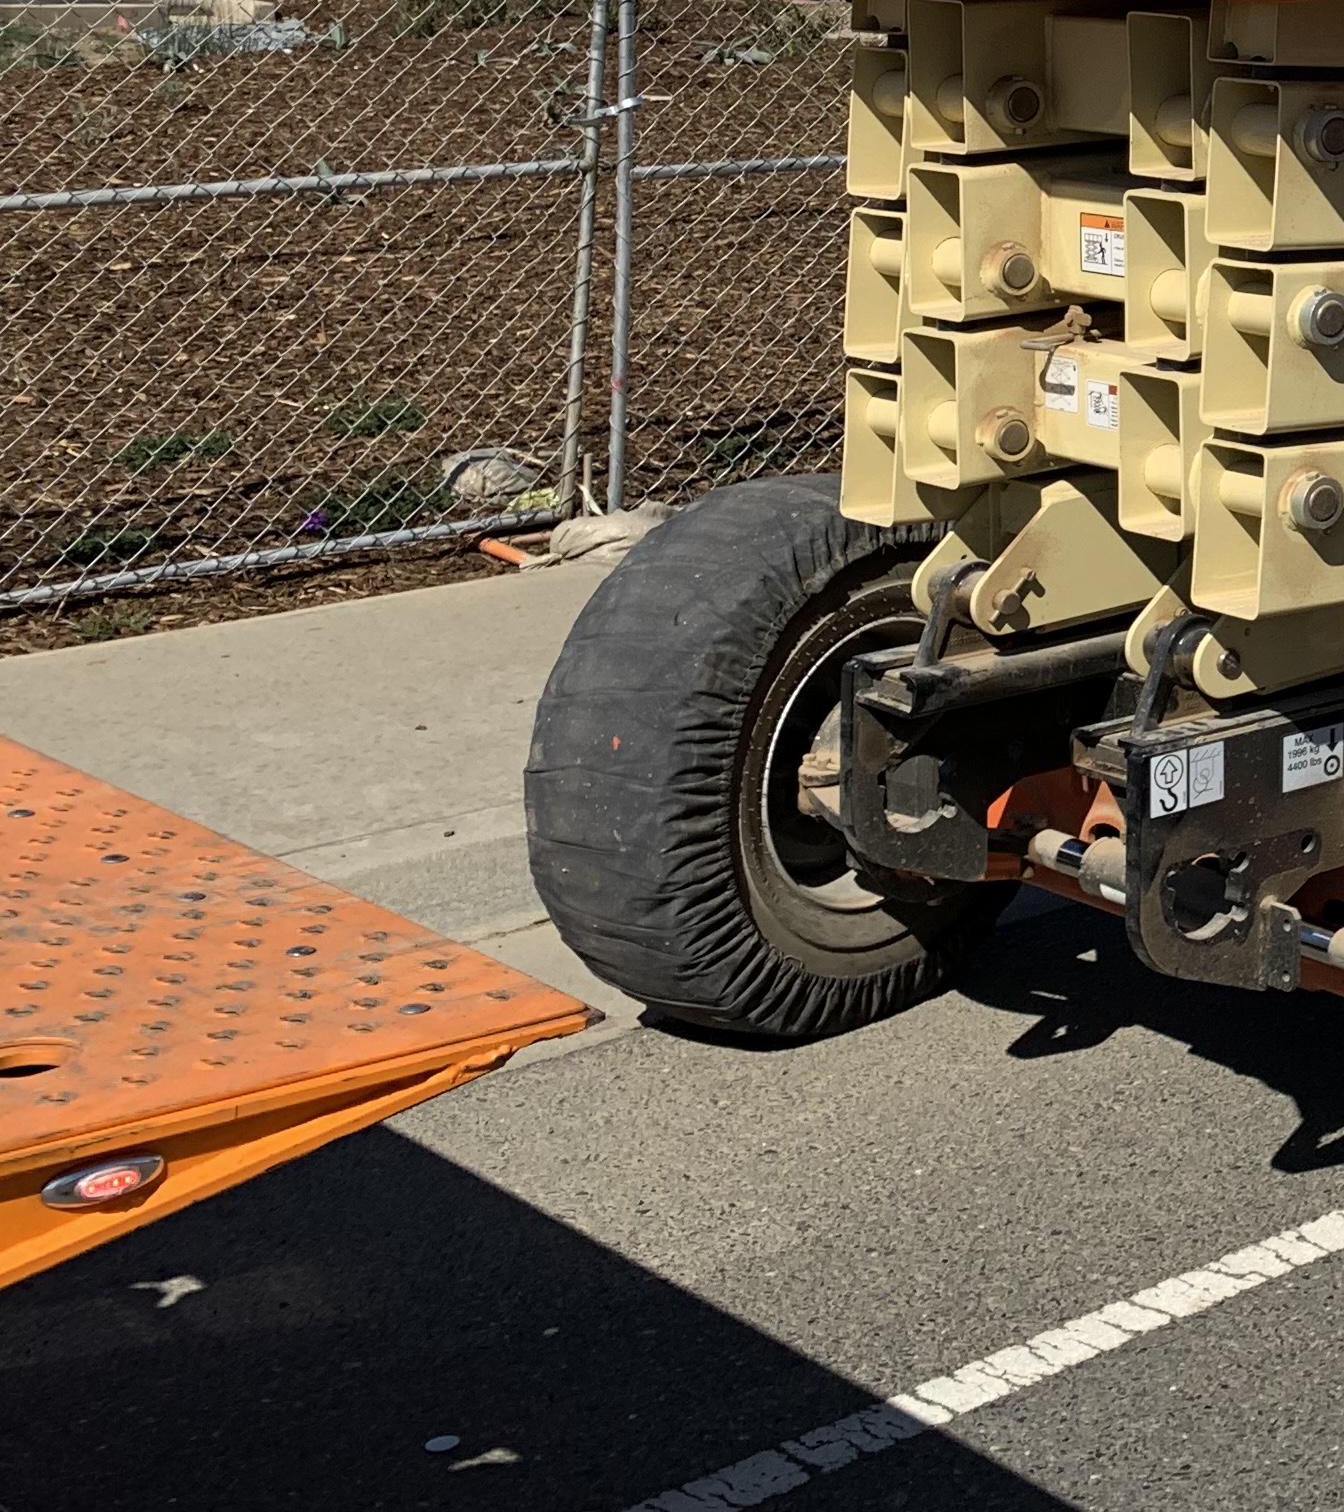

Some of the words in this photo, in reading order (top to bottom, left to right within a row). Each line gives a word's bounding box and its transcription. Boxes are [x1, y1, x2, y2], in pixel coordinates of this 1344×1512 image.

[1294, 733, 1314, 747] MAX
[1309, 744, 1321, 755] kg
[1288, 758, 1308, 772] 4400
[1309, 755, 1322, 767] lbs
